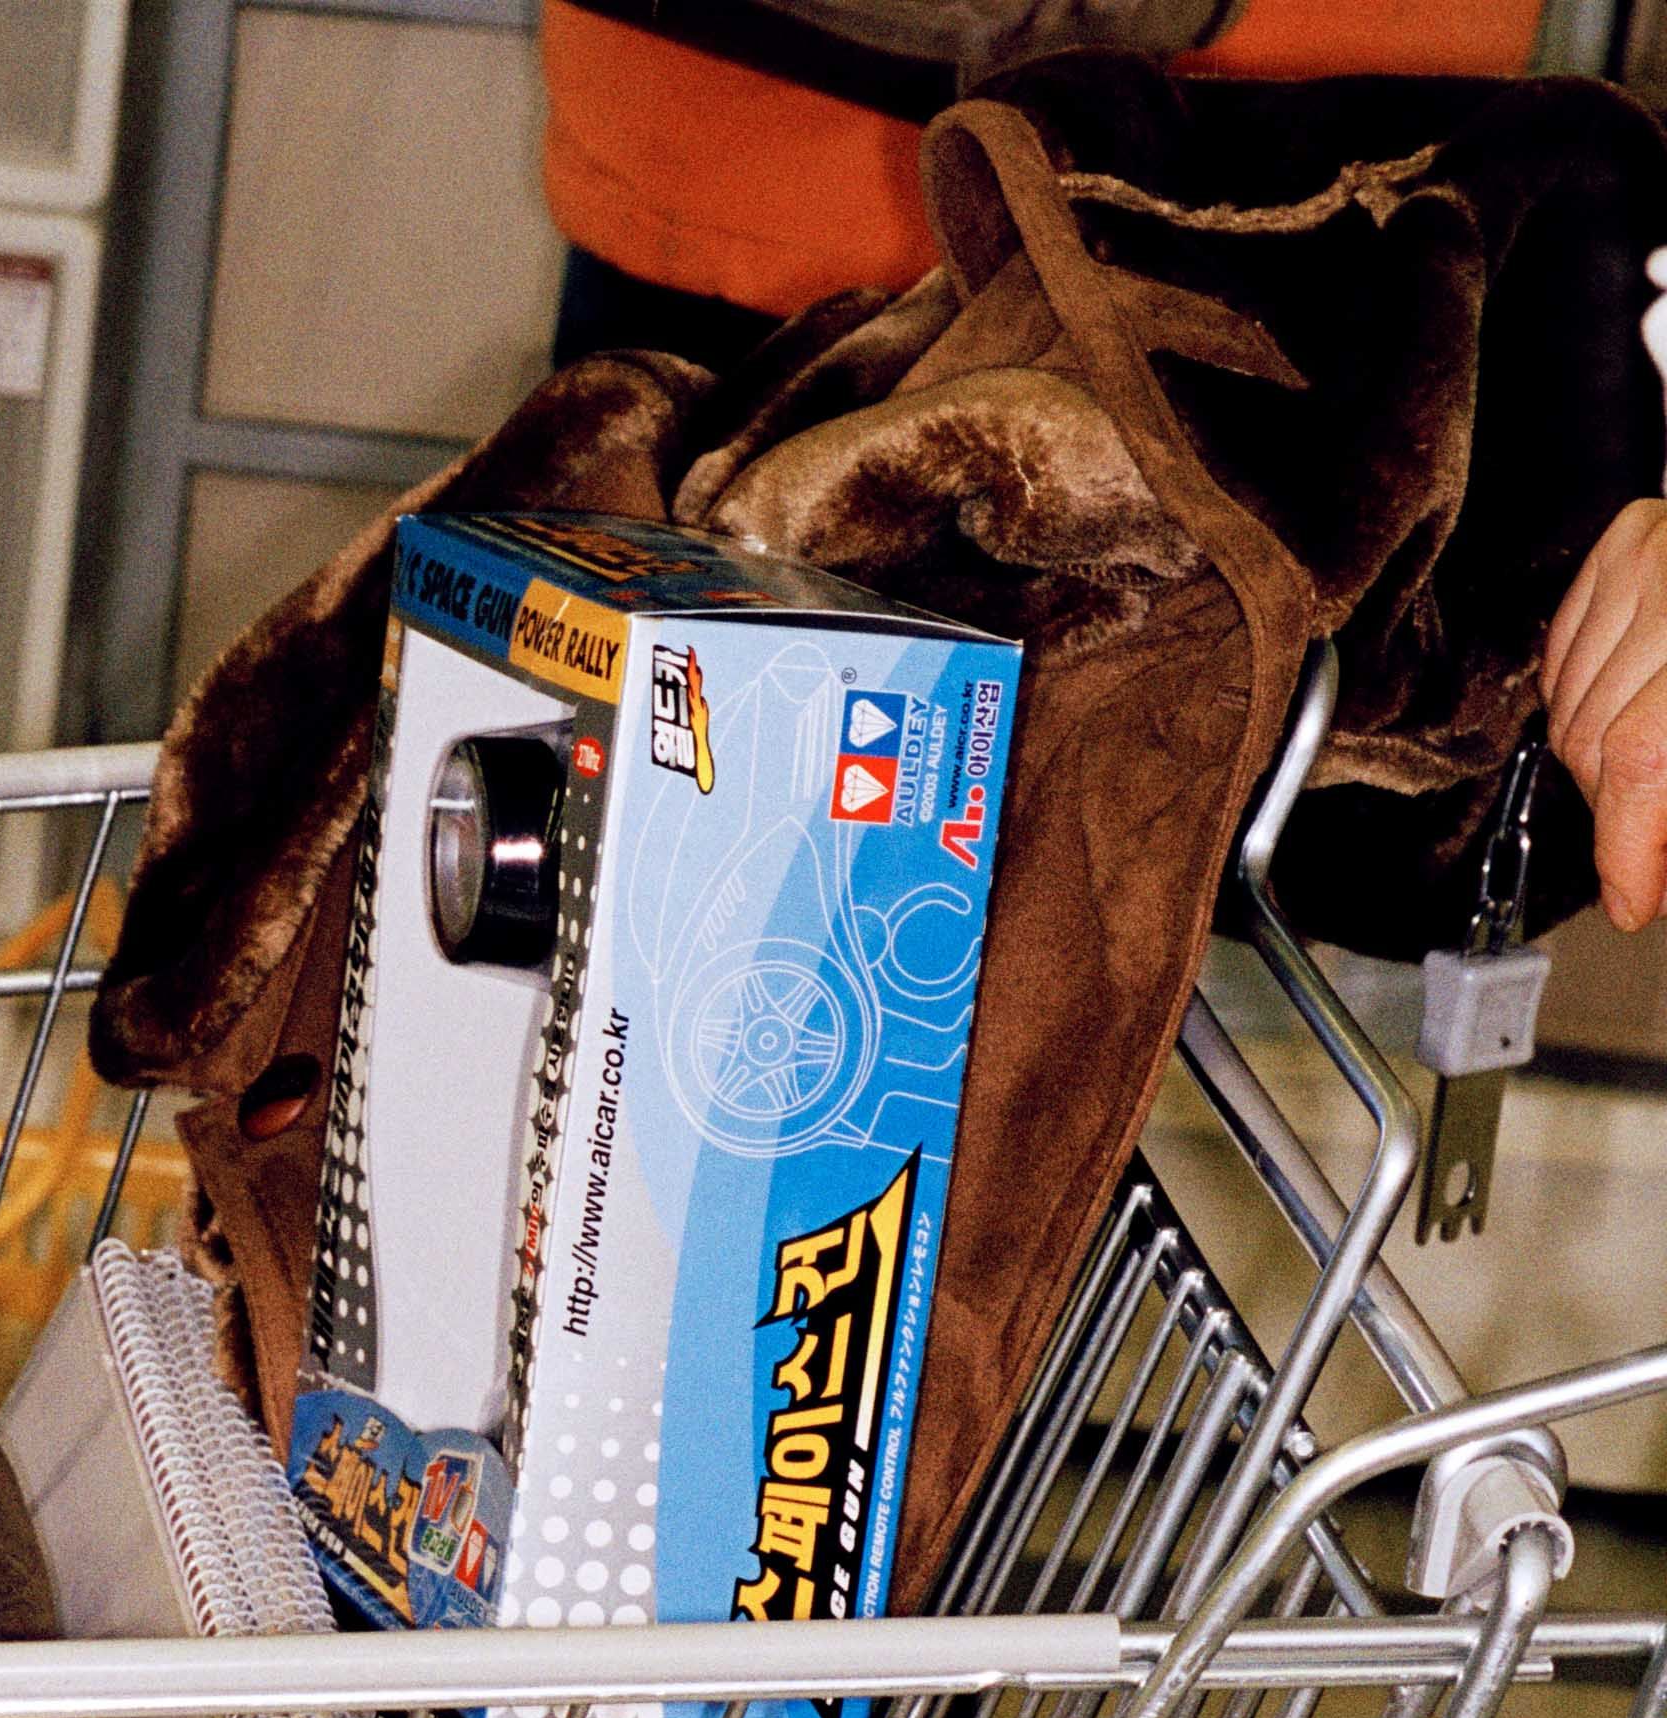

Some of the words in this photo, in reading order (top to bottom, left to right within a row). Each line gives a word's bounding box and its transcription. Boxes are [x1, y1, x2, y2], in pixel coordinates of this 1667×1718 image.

[420, 559, 469, 624] SPACE
[472, 575, 514, 641] GUN
[516, 600, 566, 659] POWER
[569, 624, 618, 680] RALLY
[896, 697, 925, 824] AULDEY
[925, 705, 946, 768] AULDEY
[969, 682, 1003, 777] 아이산업
[563, 1006, 632, 1335] http://www.aicar.co.kr
[838, 1460, 868, 1553] GUN
[877, 1427, 902, 1499] CONTROL
[867, 1500, 891, 1567] REMOTE
